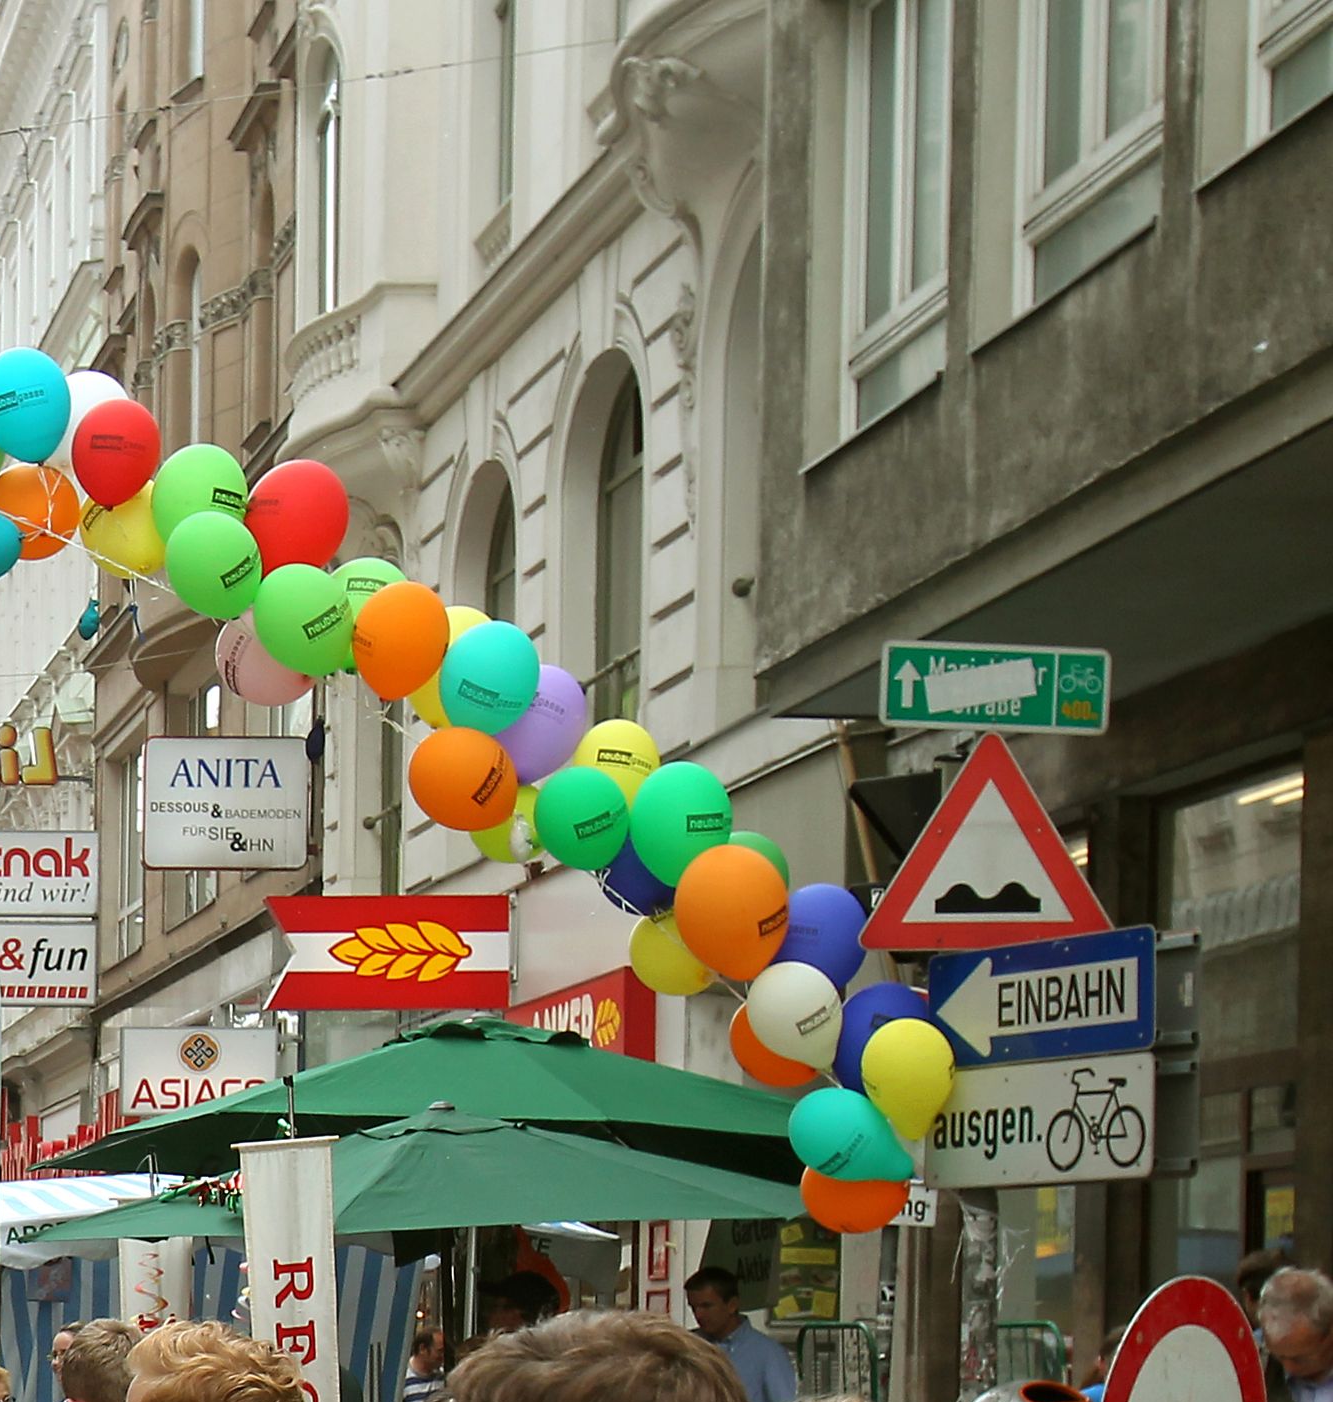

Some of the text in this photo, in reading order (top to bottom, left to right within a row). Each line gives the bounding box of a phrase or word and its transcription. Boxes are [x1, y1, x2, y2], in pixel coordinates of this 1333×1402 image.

[170, 758, 282, 788] ANITA
[150, 802, 302, 819] DESSOUS & BADEMODEN
[690, 814, 725, 830] neubau
[183, 825, 206, 836] FÜR
[208, 827, 236, 841] SIE
[230, 832, 247, 852] &
[41, 882, 91, 903] wir!
[998, 967, 1125, 1028] EINBAHN
[934, 1104, 1042, 1161] ausgen.
